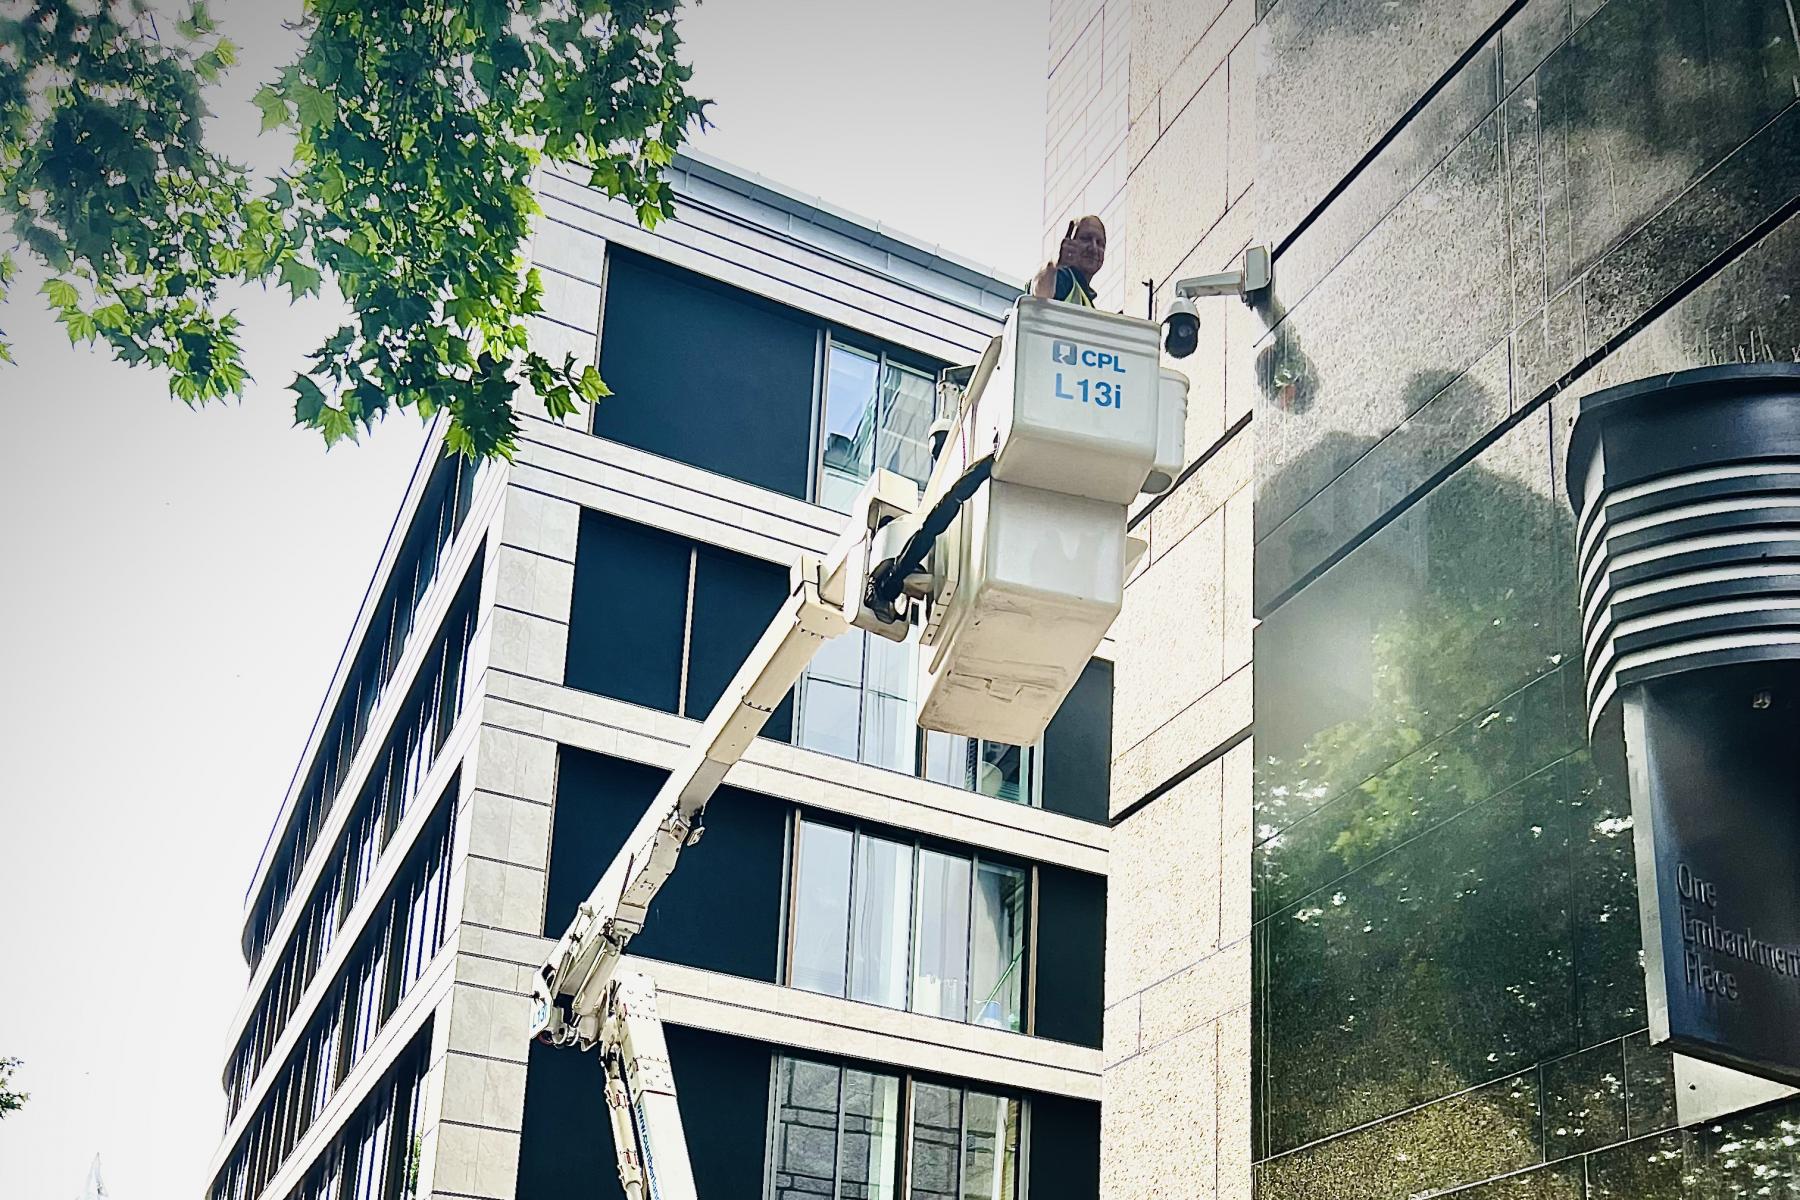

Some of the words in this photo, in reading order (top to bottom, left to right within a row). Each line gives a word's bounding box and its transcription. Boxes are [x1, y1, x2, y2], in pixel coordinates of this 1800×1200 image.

[1081, 350, 1126, 373] CPL
[1055, 373, 1121, 409] L13i
[1677, 863, 1718, 907] One
[1681, 905, 1800, 979] Embankment
[1684, 948, 1738, 1000] Place
